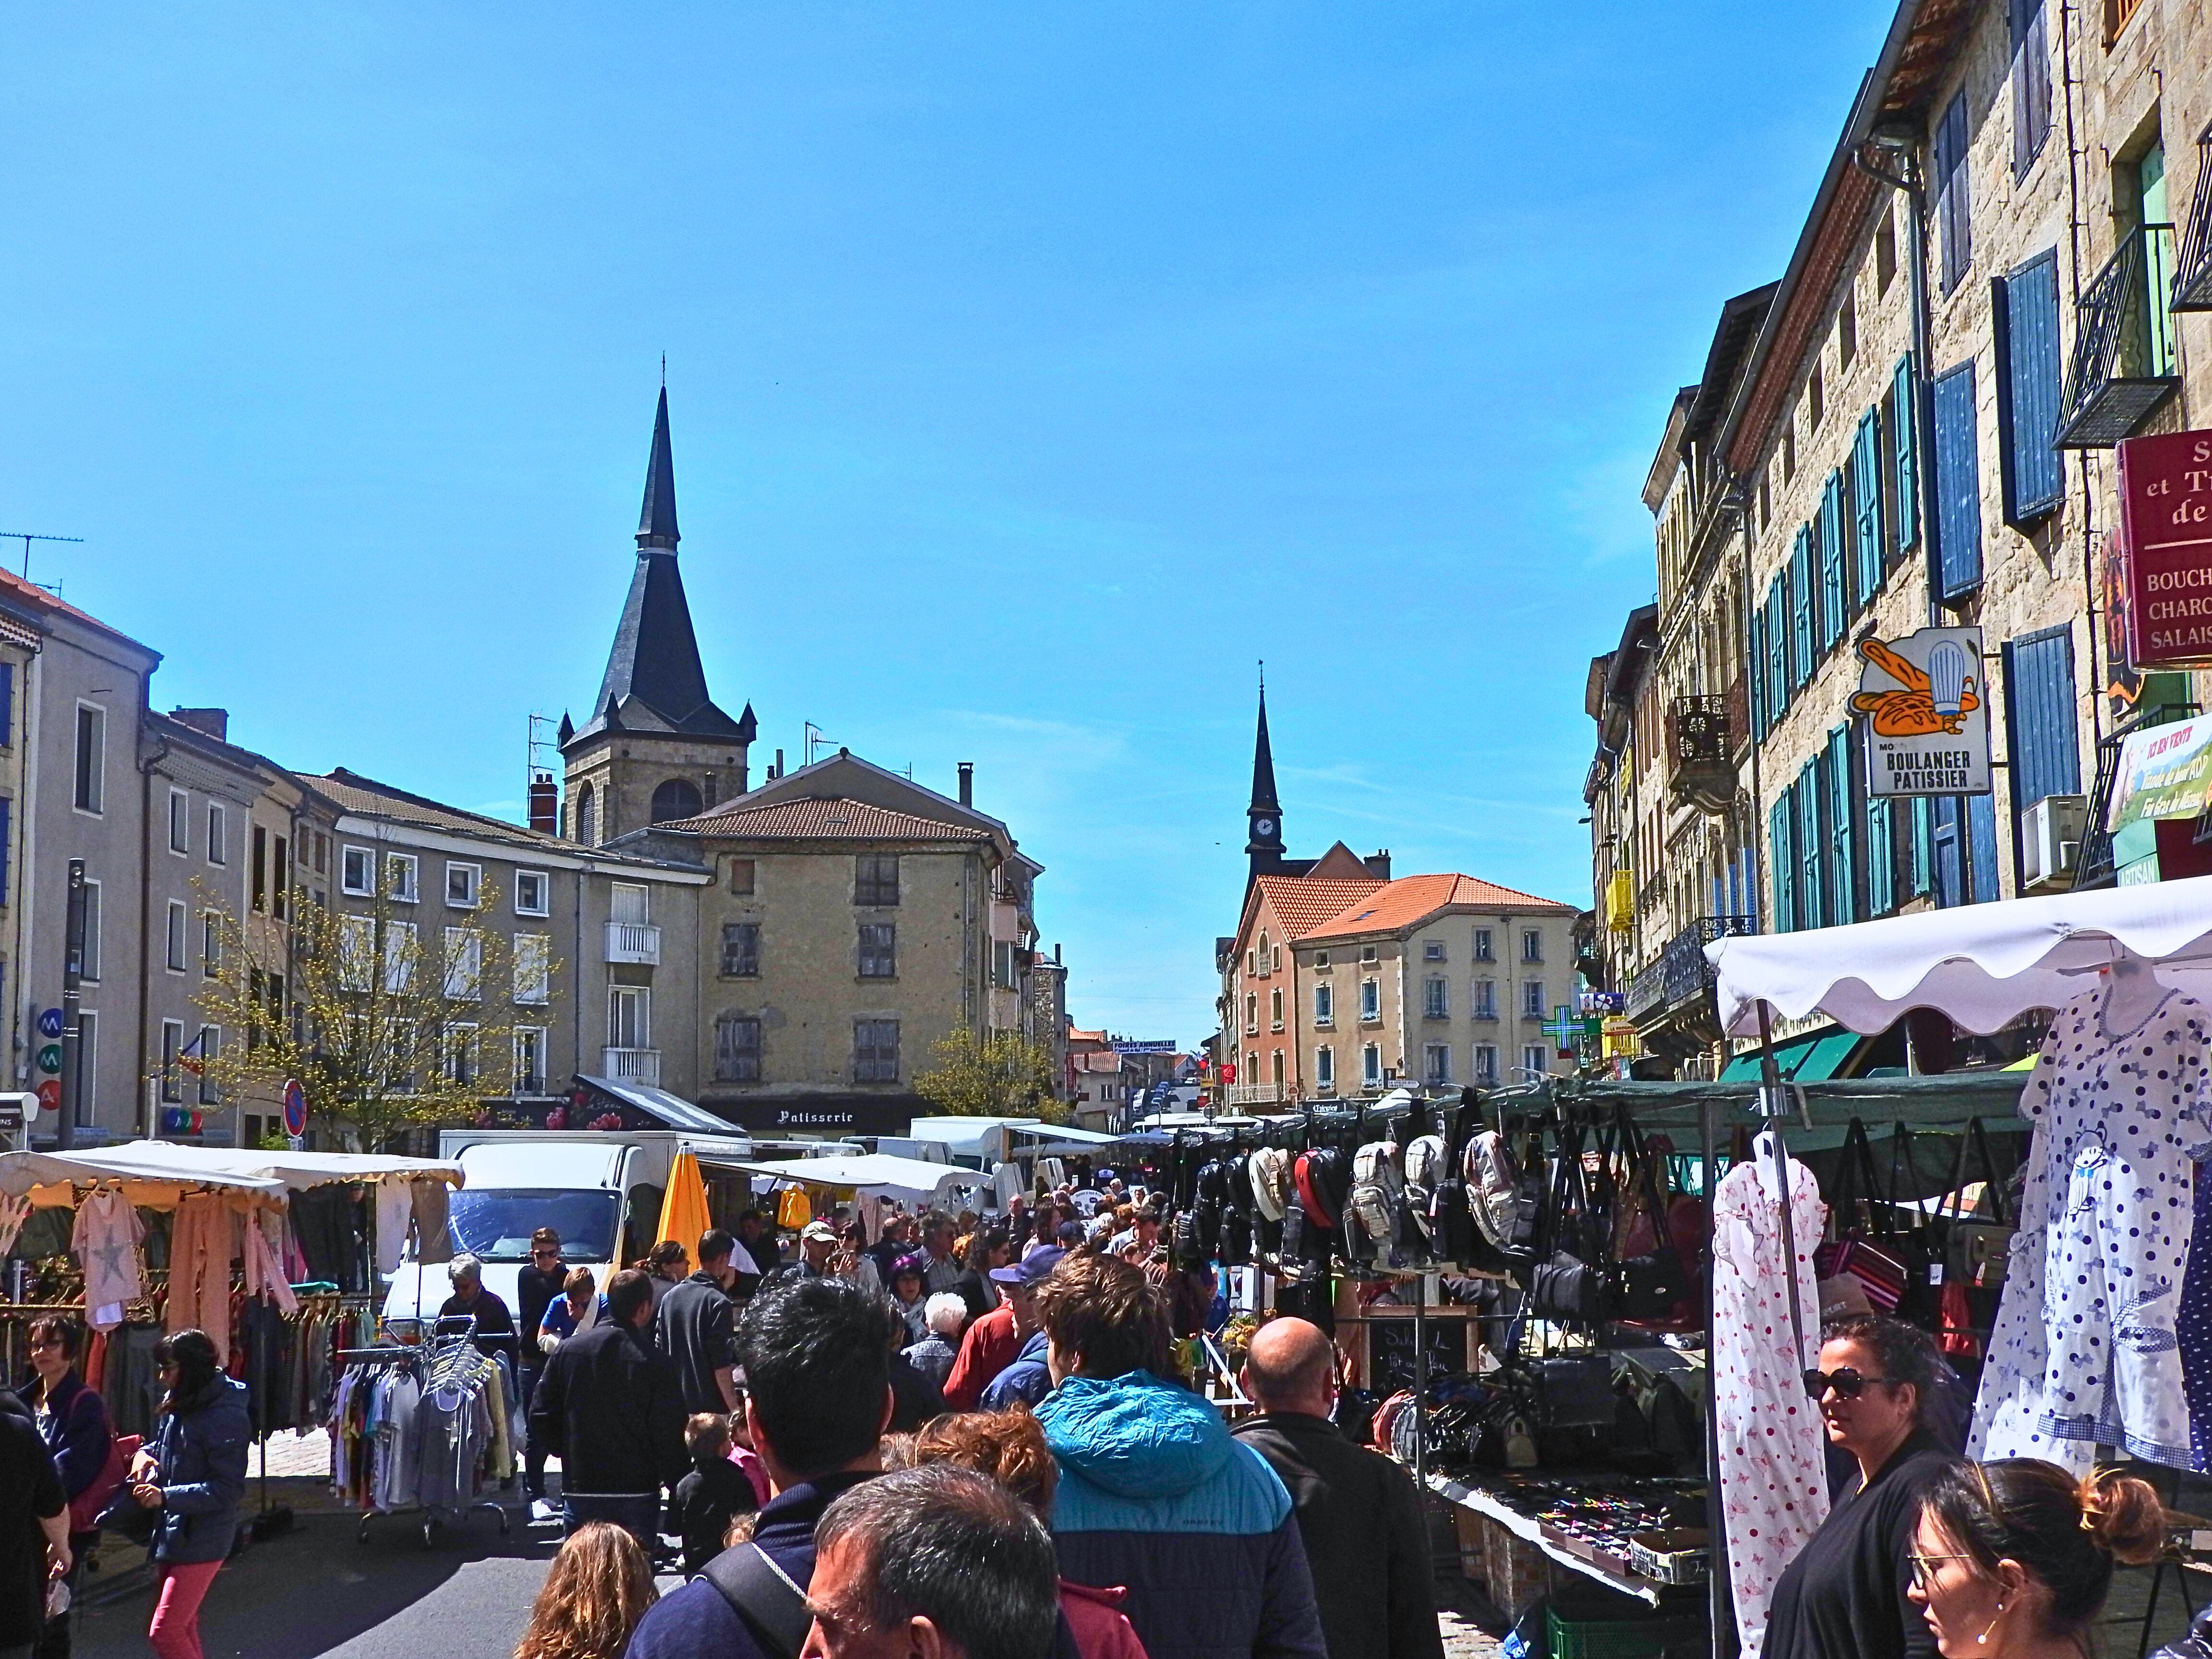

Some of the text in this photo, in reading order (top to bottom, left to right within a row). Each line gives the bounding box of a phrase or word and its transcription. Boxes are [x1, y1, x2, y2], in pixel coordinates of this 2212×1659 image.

[2192, 441, 2211, 462] S
[2146, 479, 2170, 497] et
[2172, 498, 2209, 525] de
[2147, 567, 2212, 592] BOUCH
[2148, 597, 2212, 620] CHARC
[2157, 736, 2169, 755] EN
[2169, 725, 2193, 750] VENTE
[1887, 750, 1971, 771] BOULANGER
[2164, 766, 2175, 787] de
[2188, 755, 2209, 781] AOP
[1893, 769, 1968, 790] PATISSIER
[2140, 797, 2155, 818] Fin
[2153, 795, 2171, 817] Gras
[2168, 791, 2180, 813] du
[2121, 859, 2155, 887] ARTISAN
[777, 1110, 853, 1124] Patisserie
[1389, 1352, 1403, 1367] Pot
[1427, 1350, 1449, 1376] feu
